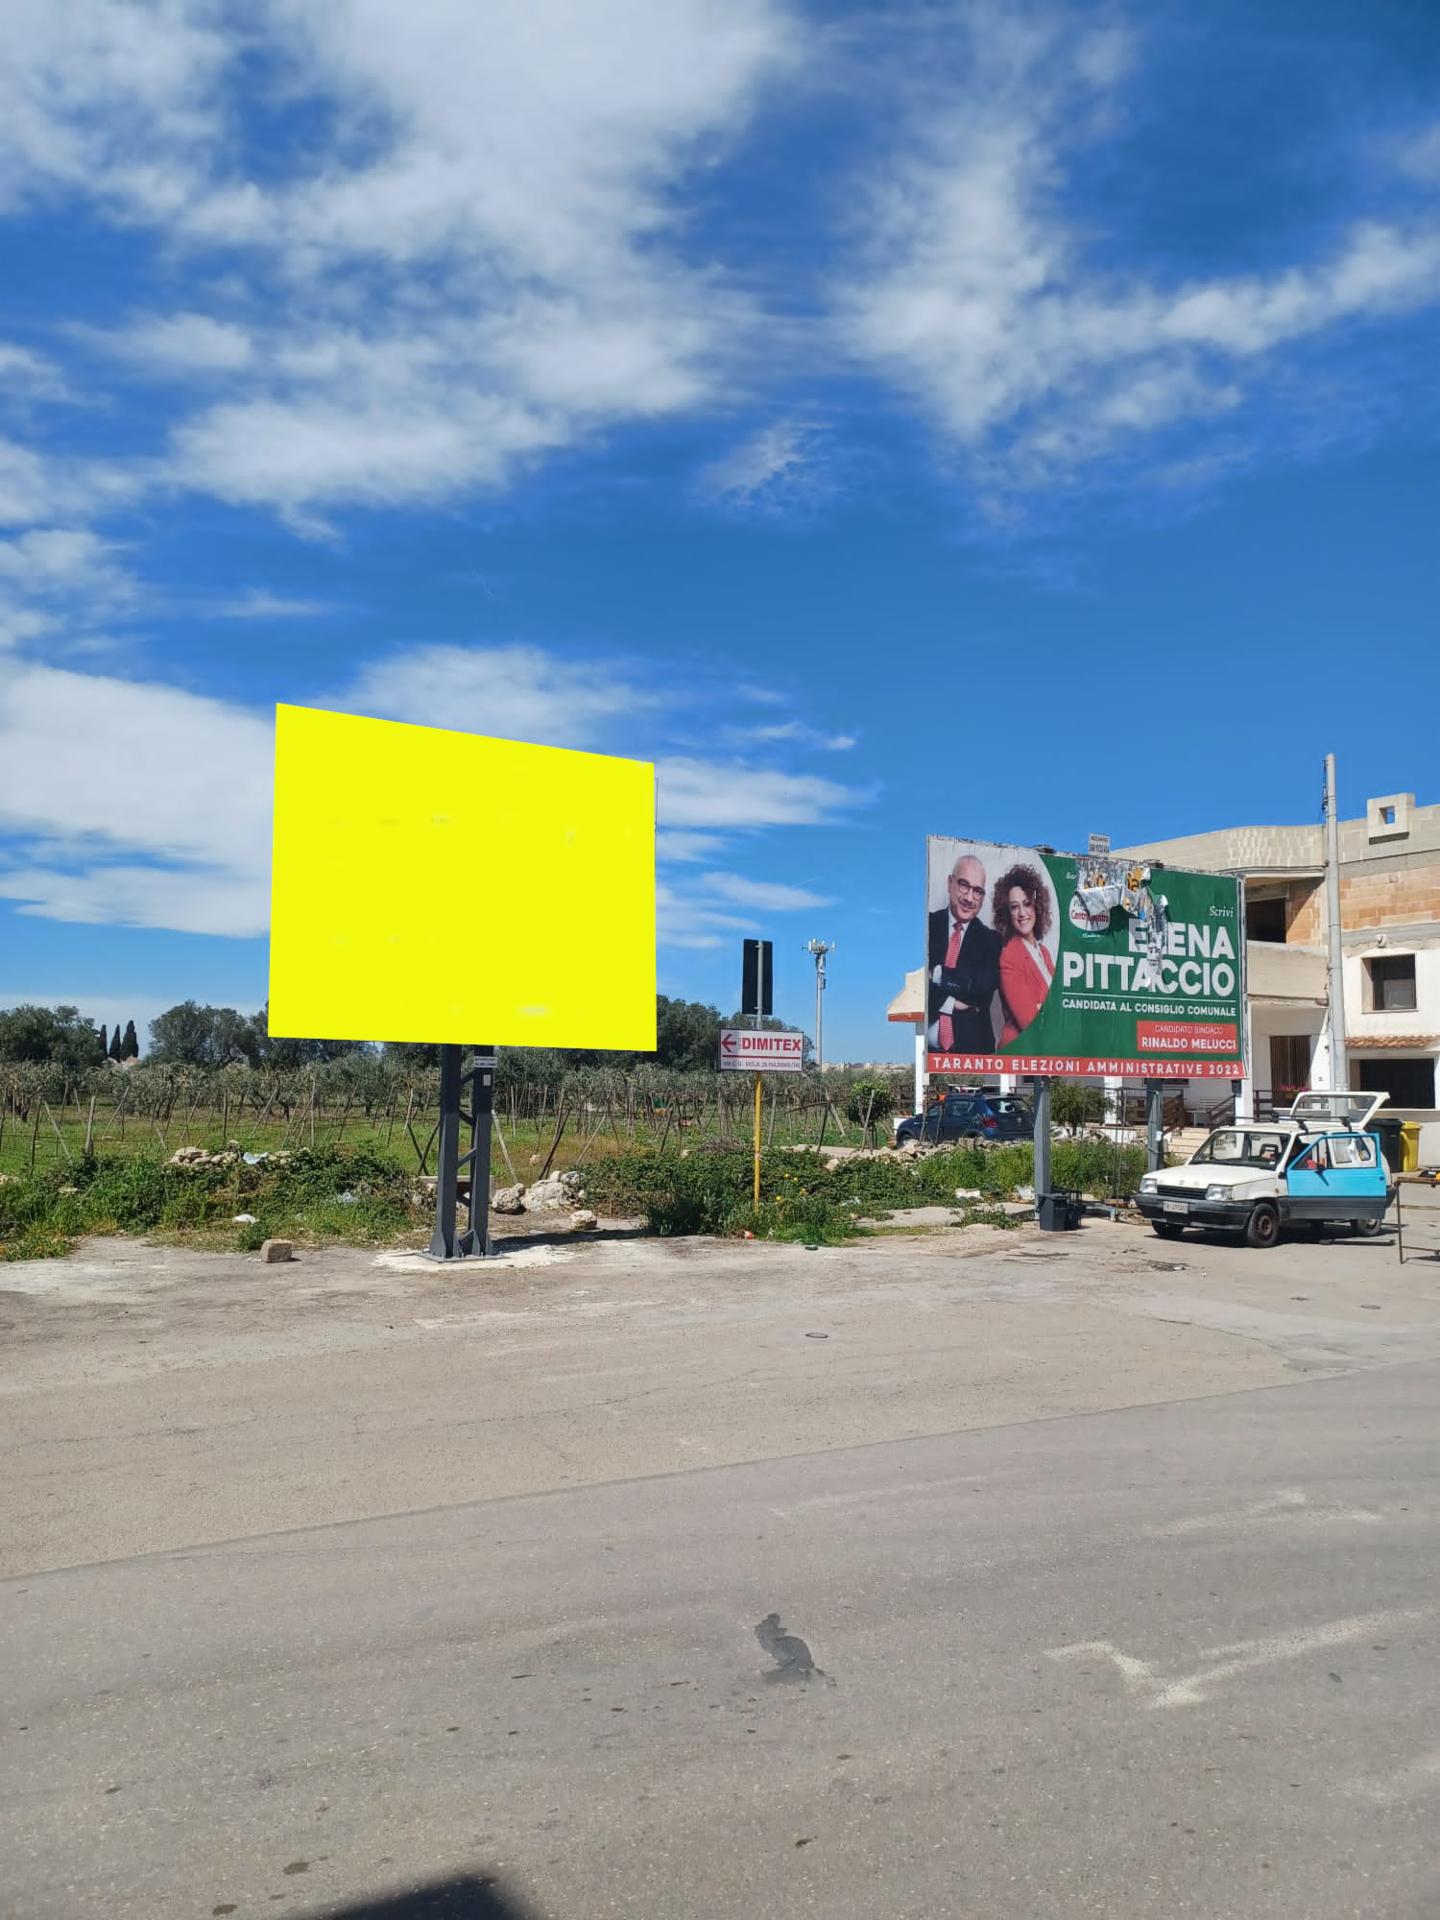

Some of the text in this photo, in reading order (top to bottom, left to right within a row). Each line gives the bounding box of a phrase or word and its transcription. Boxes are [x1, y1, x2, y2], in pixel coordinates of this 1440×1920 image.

[1209, 905, 1234, 918] Scrivi
[1128, 918, 1236, 960] EENA
[1062, 951, 1235, 997] PITTACCIO
[1062, 998, 1236, 1017] CANDIDATA AL CONSIGLIO COMUNALE
[1154, 1024, 1224, 1035] CANDIDATO SINDACO
[742, 1037, 801, 1051] DIMITEX
[1141, 1036, 1236, 1050] RINALDO MELUCCI
[933, 1056, 1240, 1075] TARANTO ELEZIONI AMMINISTRATIVE 2022
